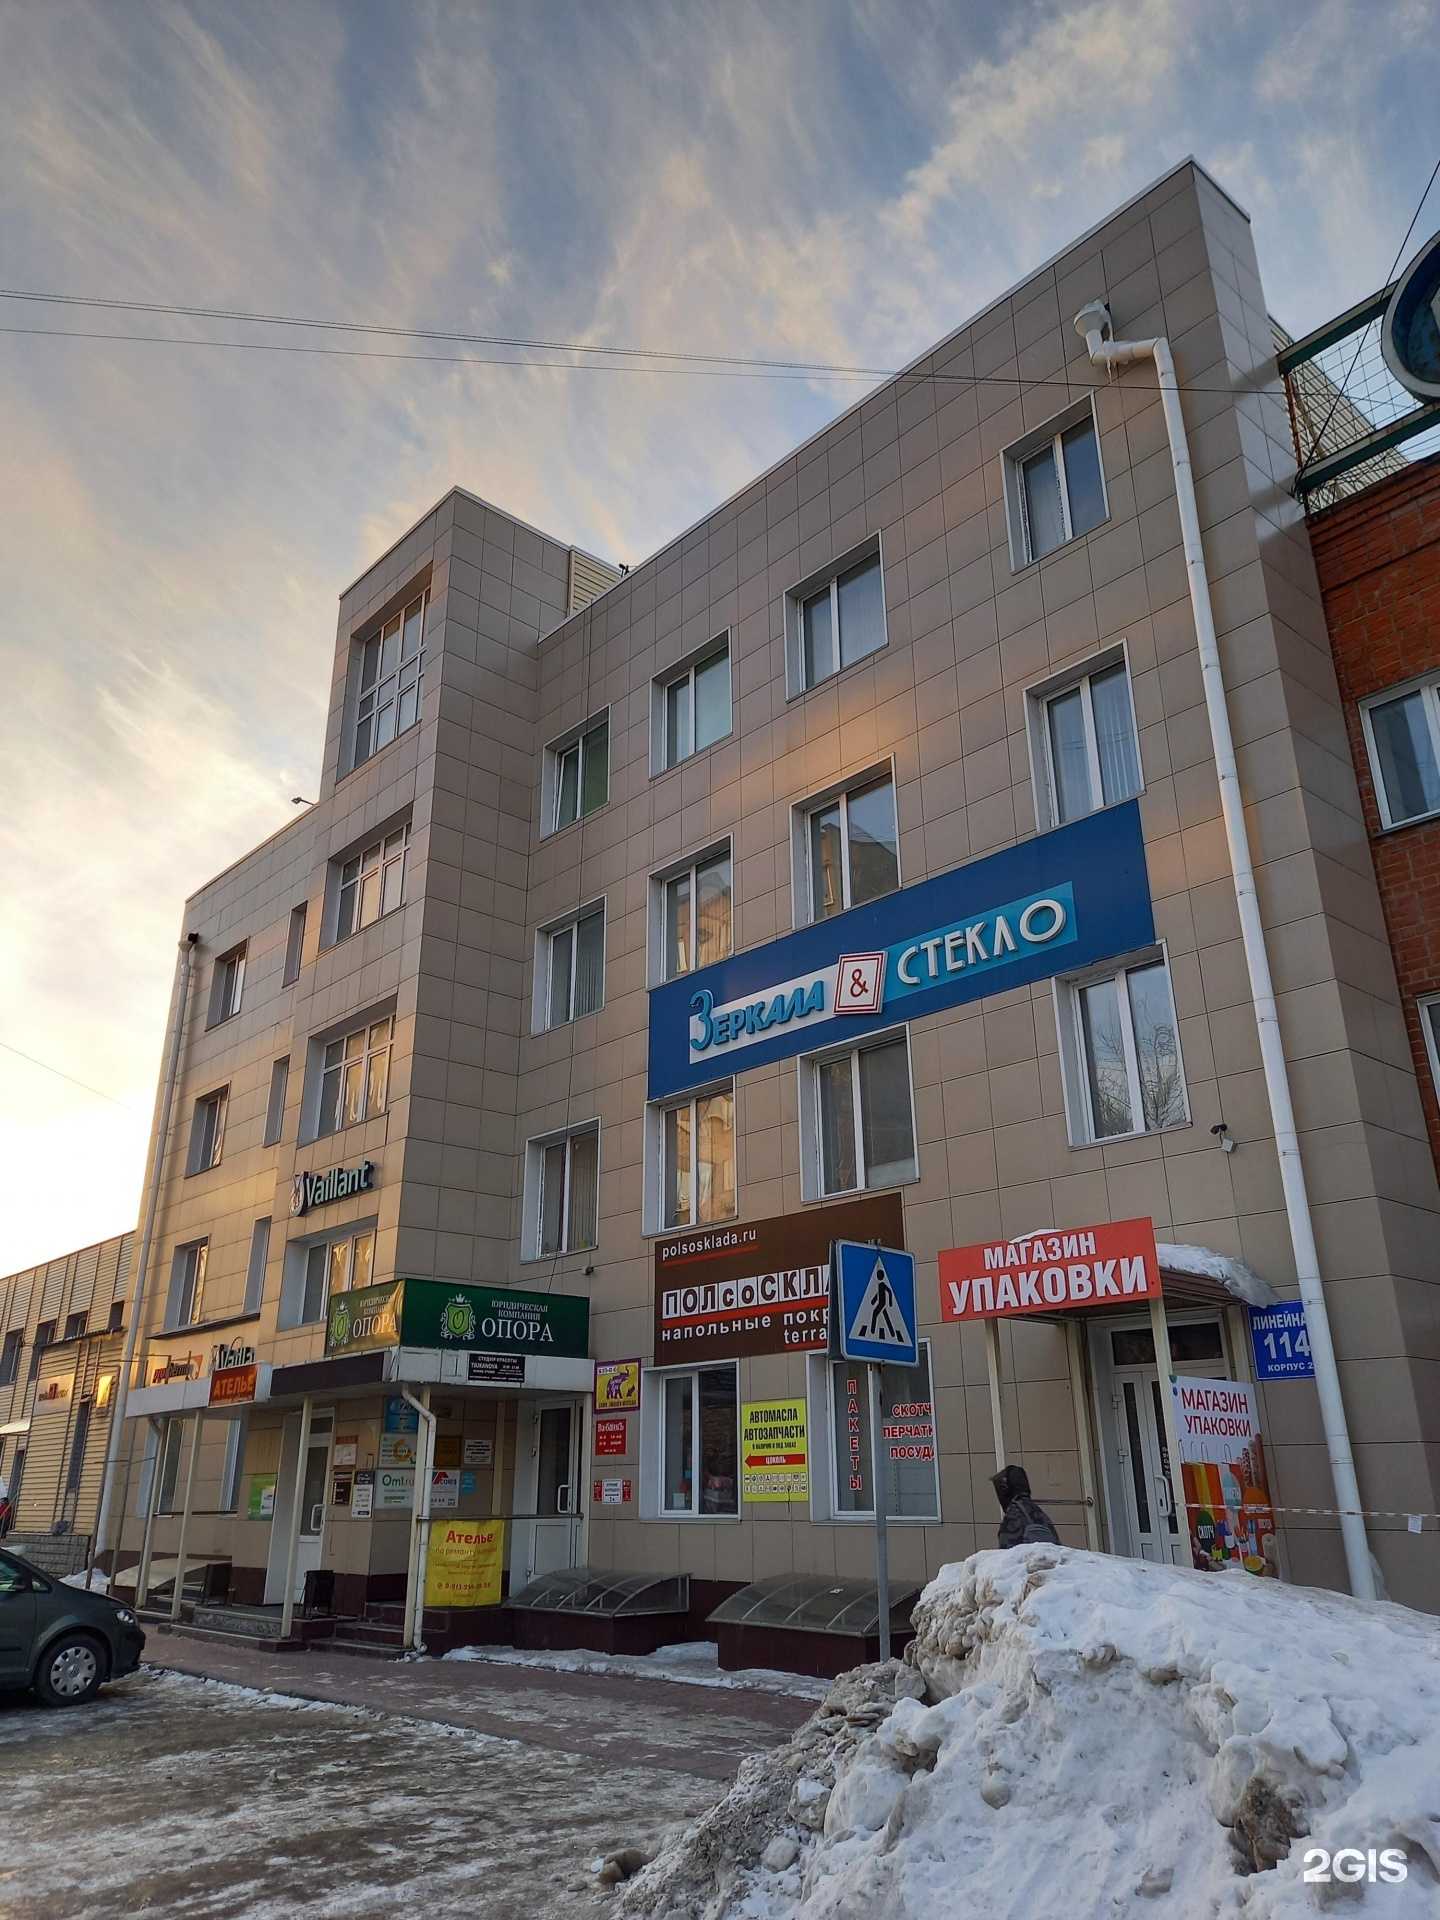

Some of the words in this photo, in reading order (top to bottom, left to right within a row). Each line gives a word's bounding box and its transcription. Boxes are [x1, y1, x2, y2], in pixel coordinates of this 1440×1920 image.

[848, 968, 870, 998] &
[896, 898, 1067, 985] СТЕКЛО
[306, 1162, 372, 1210] Vaillant
[662, 1230, 757, 1260] polsosklada.ru
[983, 1231, 1097, 1271] МАГАЗИН
[948, 1255, 1148, 1315] УПАКОВКИ
[491, 1300, 549, 1313] ЮРИДИЧЕСКАЯ
[498, 1309, 541, 1321] КОМПАНИЯ
[352, 1313, 397, 1338] ОПОРА
[481, 1317, 555, 1343] ОПОРА
[661, 1314, 772, 1342] напольные
[1263, 1329, 1311, 1360] 114
[1267, 1362, 1306, 1373] КОРПУС
[891, 1403, 933, 1418] СКОТЧ
[1181, 1387, 1249, 1414] МАГАЗИН
[750, 1408, 798, 1424] АВТОМАСЛА
[1184, 1415, 1251, 1437] УПАКОВКИ
[744, 1425, 805, 1441] АВТОЗАПЧАСТИ
[847, 1379, 863, 1491] ПАКЕТЫ
[446, 1530, 495, 1545] Ателье
